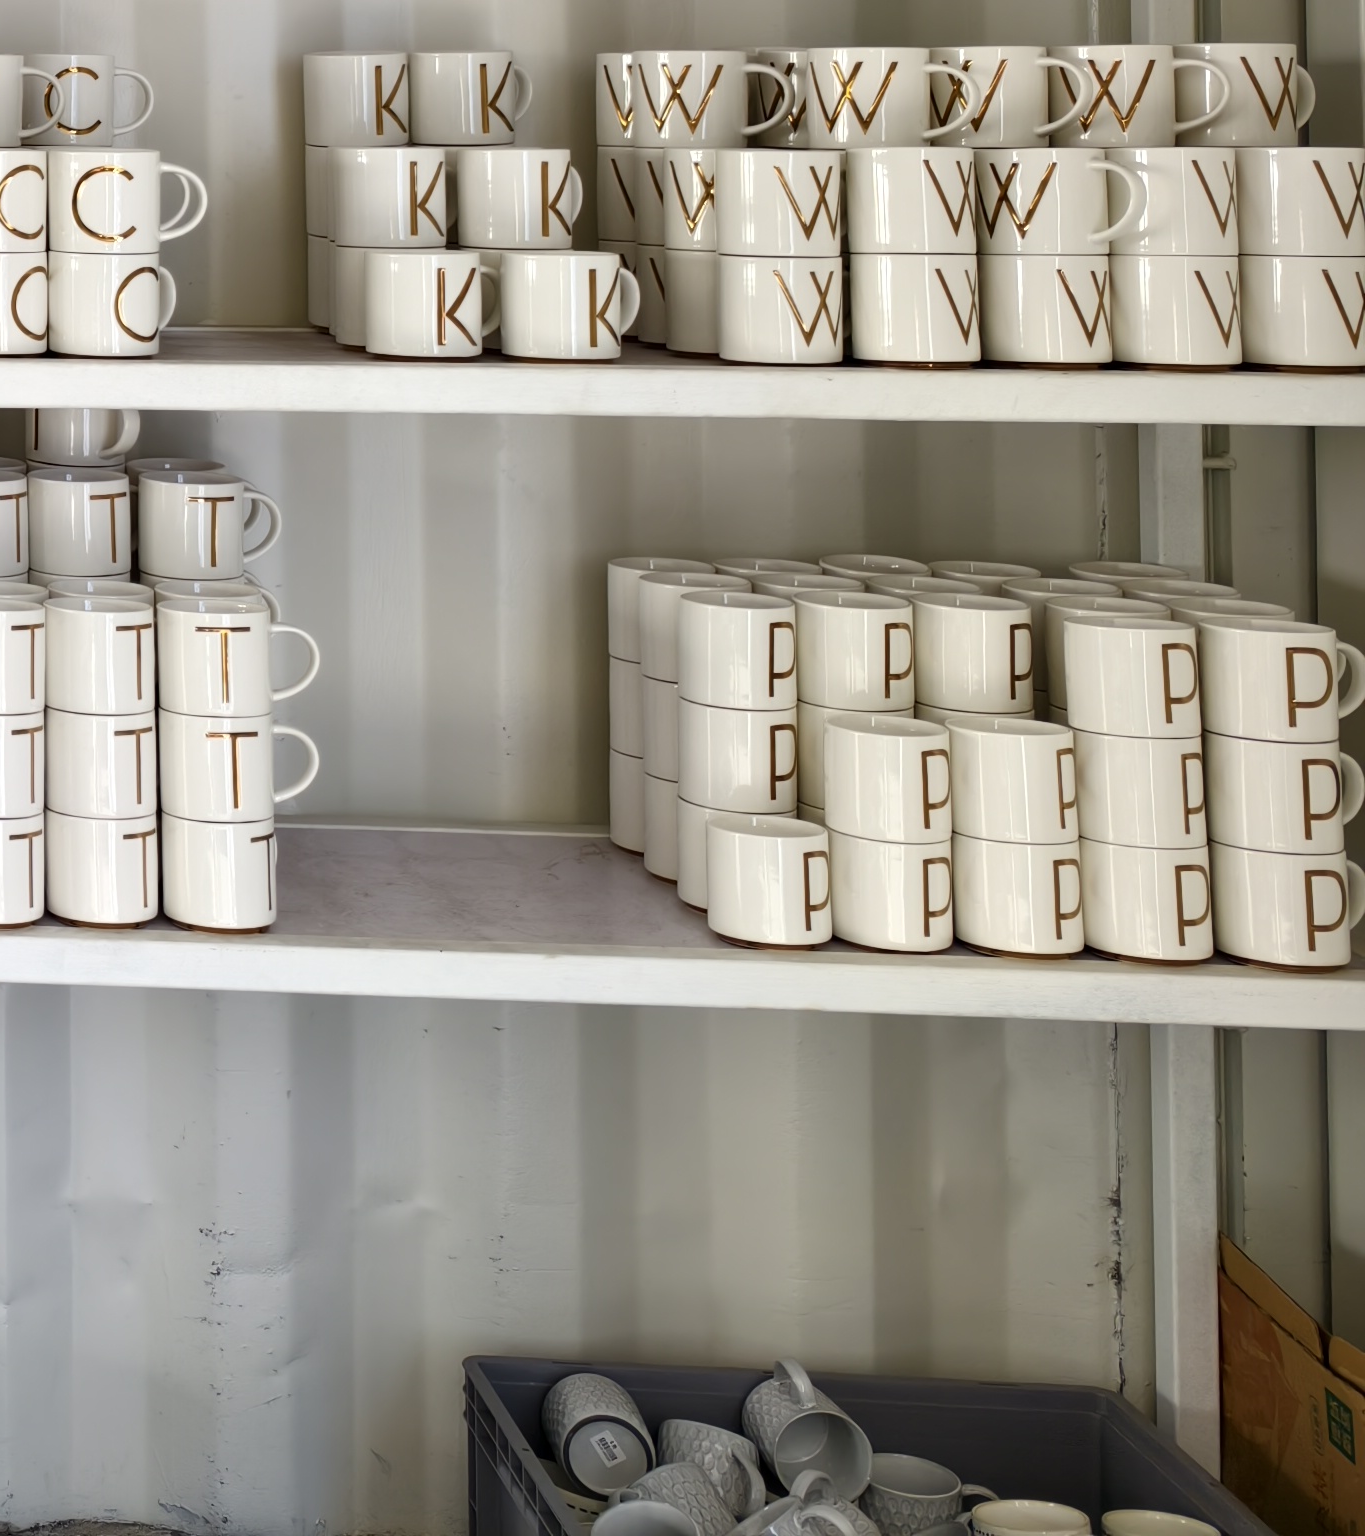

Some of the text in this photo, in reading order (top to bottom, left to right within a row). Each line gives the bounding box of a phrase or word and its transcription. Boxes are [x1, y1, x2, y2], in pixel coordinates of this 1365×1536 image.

[481, 62, 513, 134] K
[639, 64, 724, 135] W
[811, 61, 897, 135] W
[72, 165, 137, 242] C
[410, 161, 443, 237] K
[973, 162, 1057, 240] W
[437, 268, 477, 347] K
[589, 268, 621, 348] K
[774, 270, 840, 347] W
[89, 492, 126, 564] T
[188, 496, 234, 567] T
[115, 623, 152, 699] T
[195, 626, 251, 704] T
[884, 623, 912, 699] P
[1162, 643, 1196, 723] P
[1286, 647, 1333, 727] P
[205, 732, 258, 809] T
[921, 749, 950, 829] P
[1302, 759, 1340, 840] P
[123, 830, 157, 907] T
[804, 851, 829, 932] P
[1175, 864, 1210, 946] P
[1305, 870, 1347, 952] P
